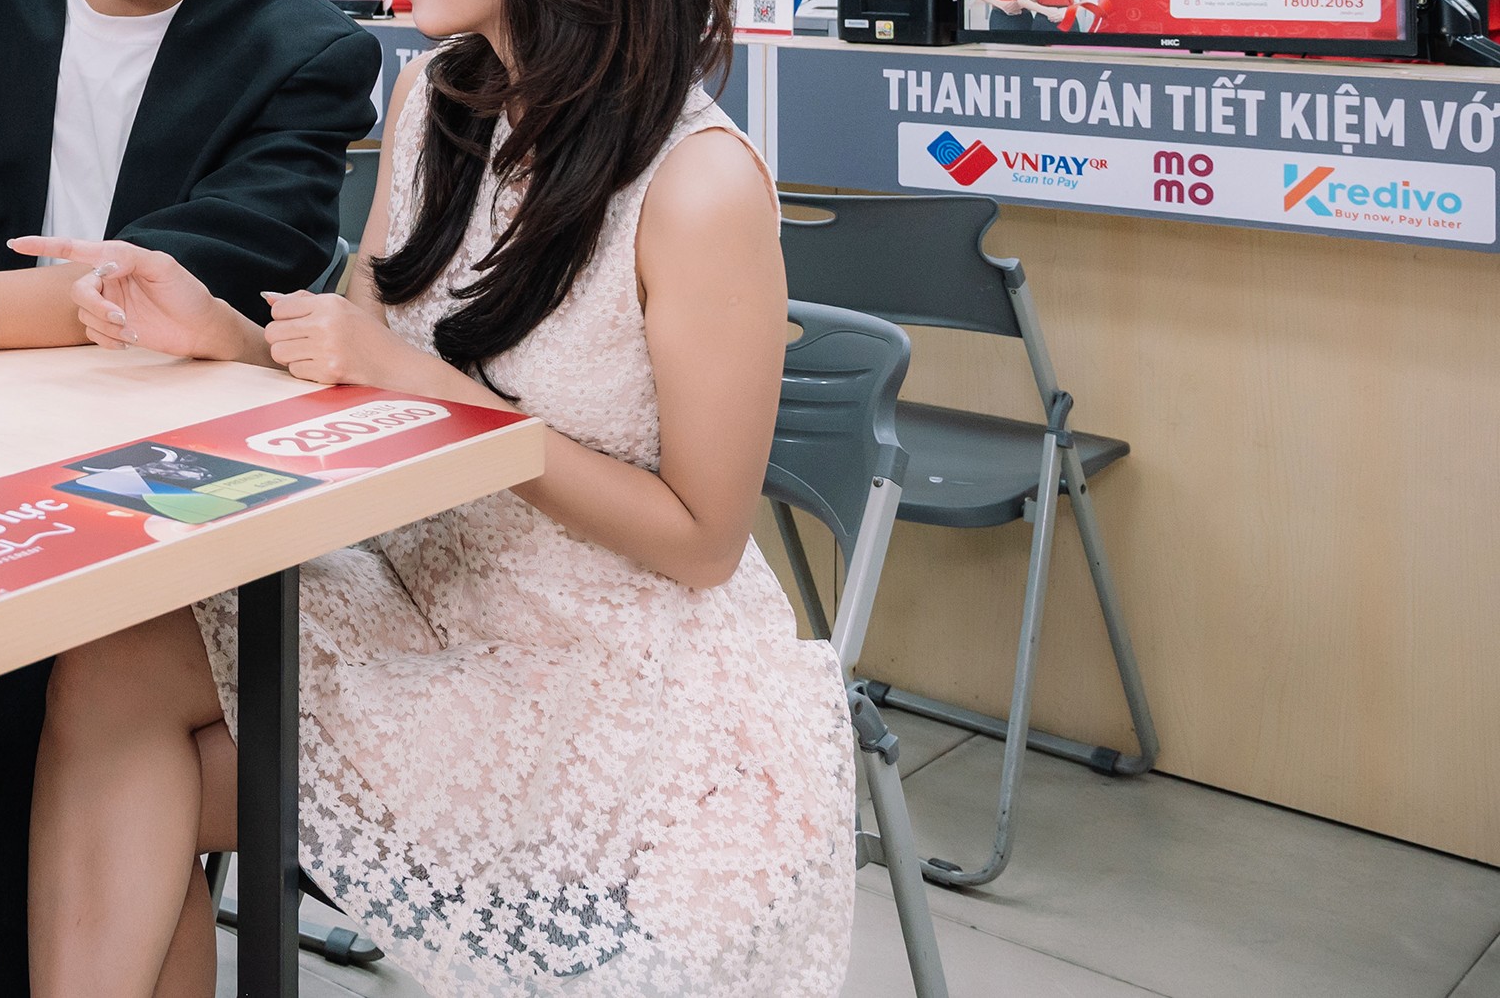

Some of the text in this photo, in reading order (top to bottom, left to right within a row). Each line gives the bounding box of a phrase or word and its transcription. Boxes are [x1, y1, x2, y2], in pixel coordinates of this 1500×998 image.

[1160, 39, 1180, 47] HKC
[882, 69, 1021, 119] THANH
[1033, 70, 1152, 128] TOÁN
[1164, 74, 1266, 136] TIẾT
[1280, 83, 1405, 154] KIỆM
[1001, 150, 1108, 176] VNPAY QR
[1012, 172, 1078, 190] Scan to Pay
[1283, 163, 1462, 217] Kredivo
[1335, 208, 1462, 229] Buy now, Pay later
[268, 408, 437, 453] 290.000
